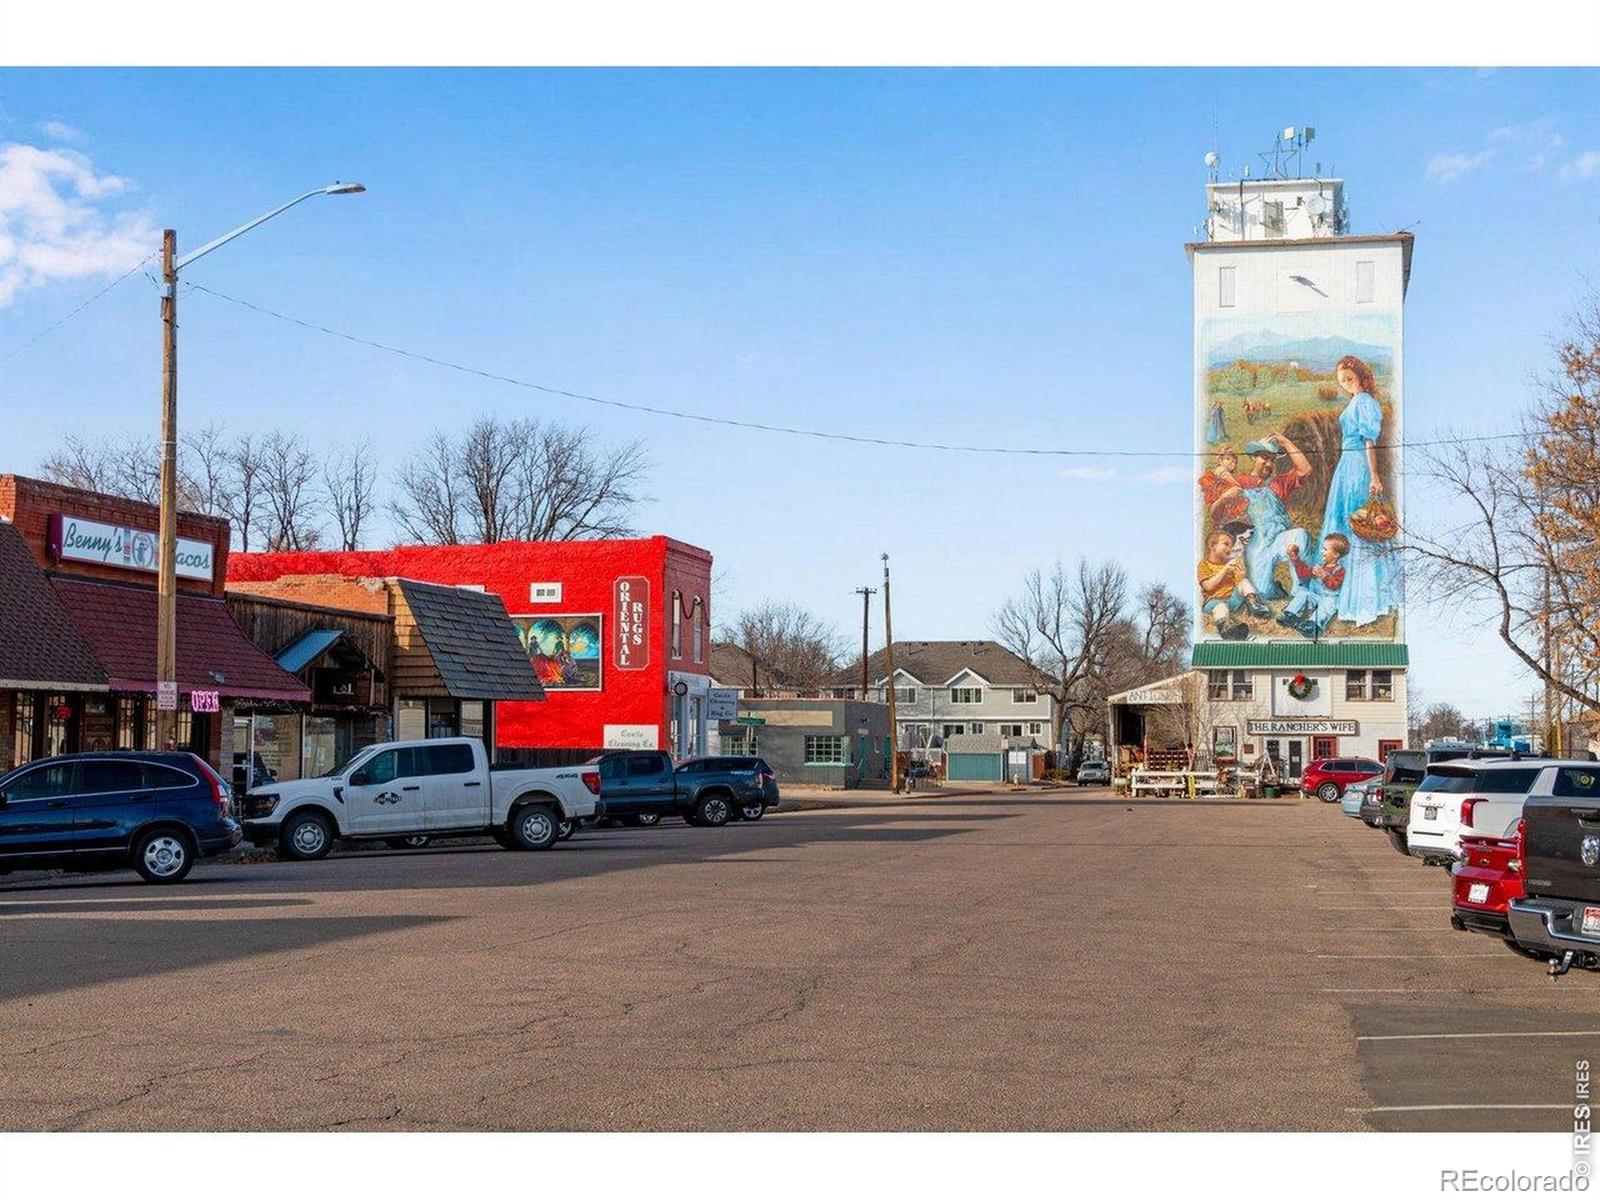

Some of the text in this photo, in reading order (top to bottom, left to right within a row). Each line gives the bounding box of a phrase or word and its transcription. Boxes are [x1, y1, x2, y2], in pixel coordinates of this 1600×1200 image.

[64, 522, 122, 561] Benny's
[174, 541, 210, 569] acos
[620, 582, 630, 665] ORIENTAL
[632, 602, 643, 645] RUGS
[191, 690, 219, 712] OPEN
[1251, 722, 1355, 732] THE RANCHER'S WIFE
